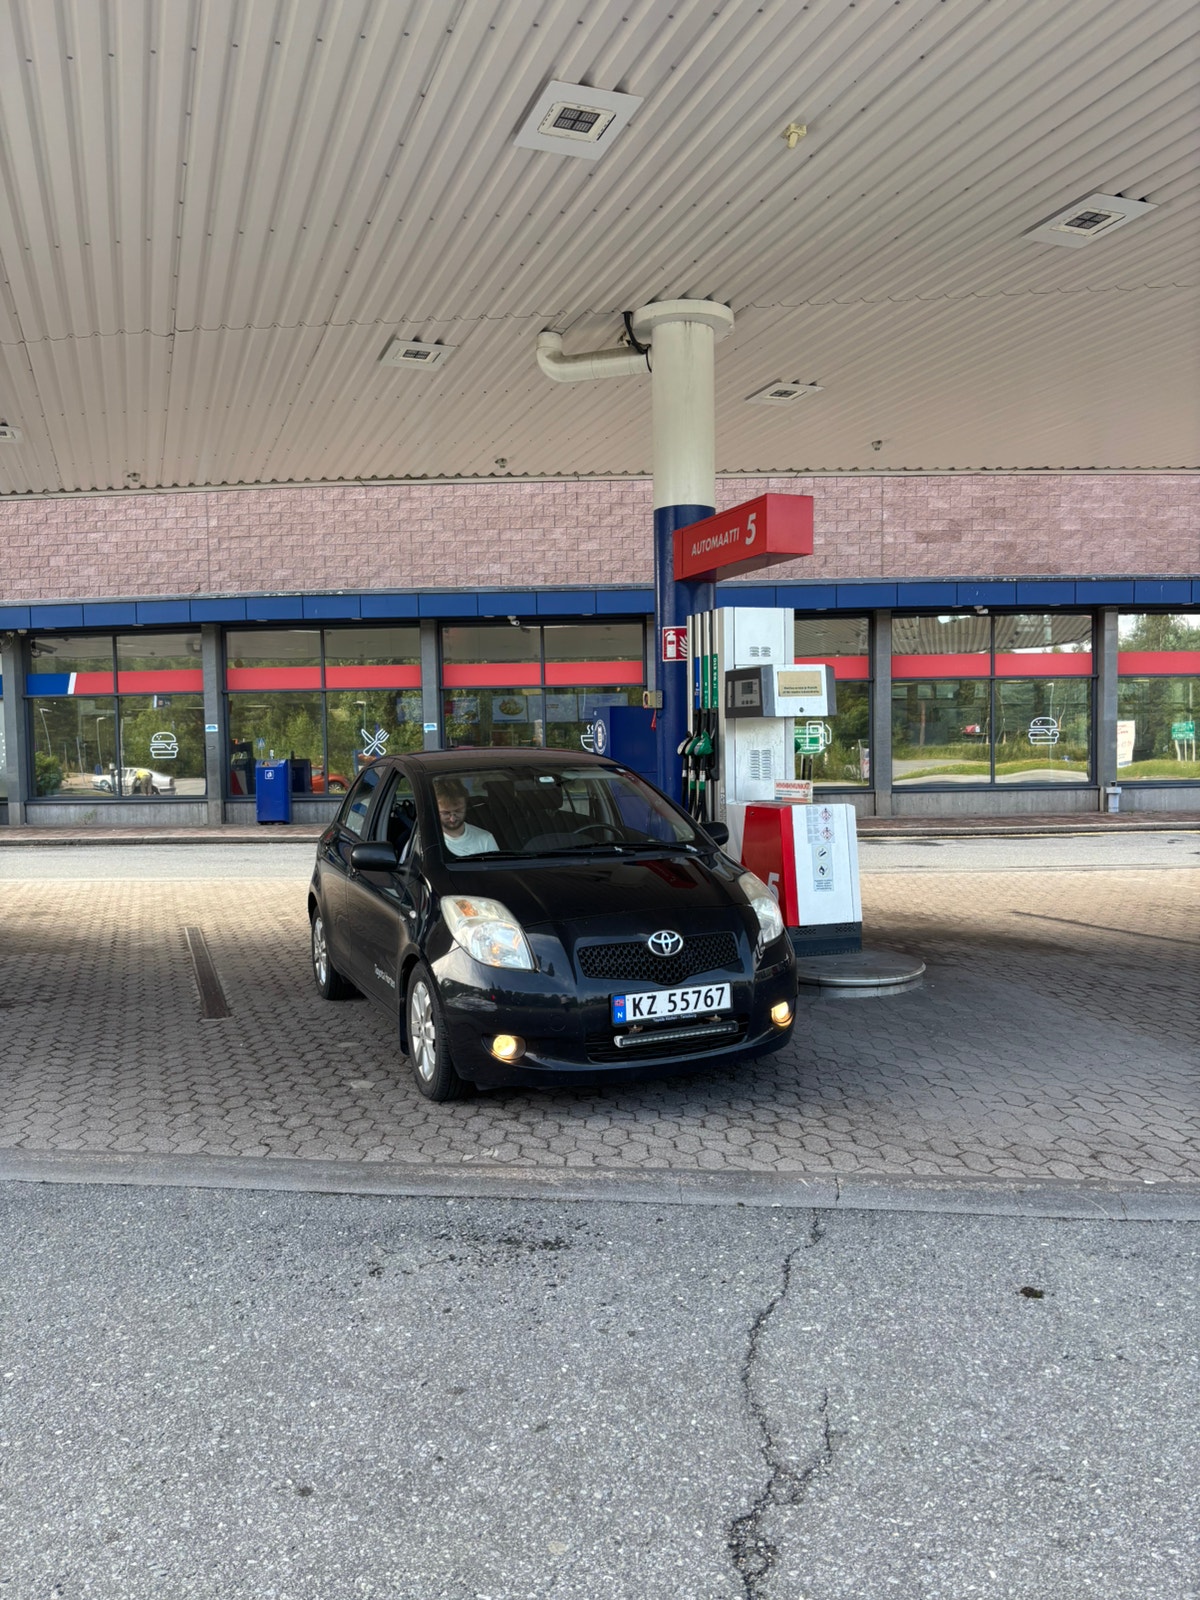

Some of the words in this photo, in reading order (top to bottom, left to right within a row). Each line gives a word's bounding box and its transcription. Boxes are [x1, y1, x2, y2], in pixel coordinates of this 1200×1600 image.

[691, 527, 740, 556] AUTOMAATTI
[745, 512, 757, 545] 5
[617, 1011, 623, 1019] N
[632, 995, 658, 1017] KZ
[667, 986, 725, 1013] 55767
